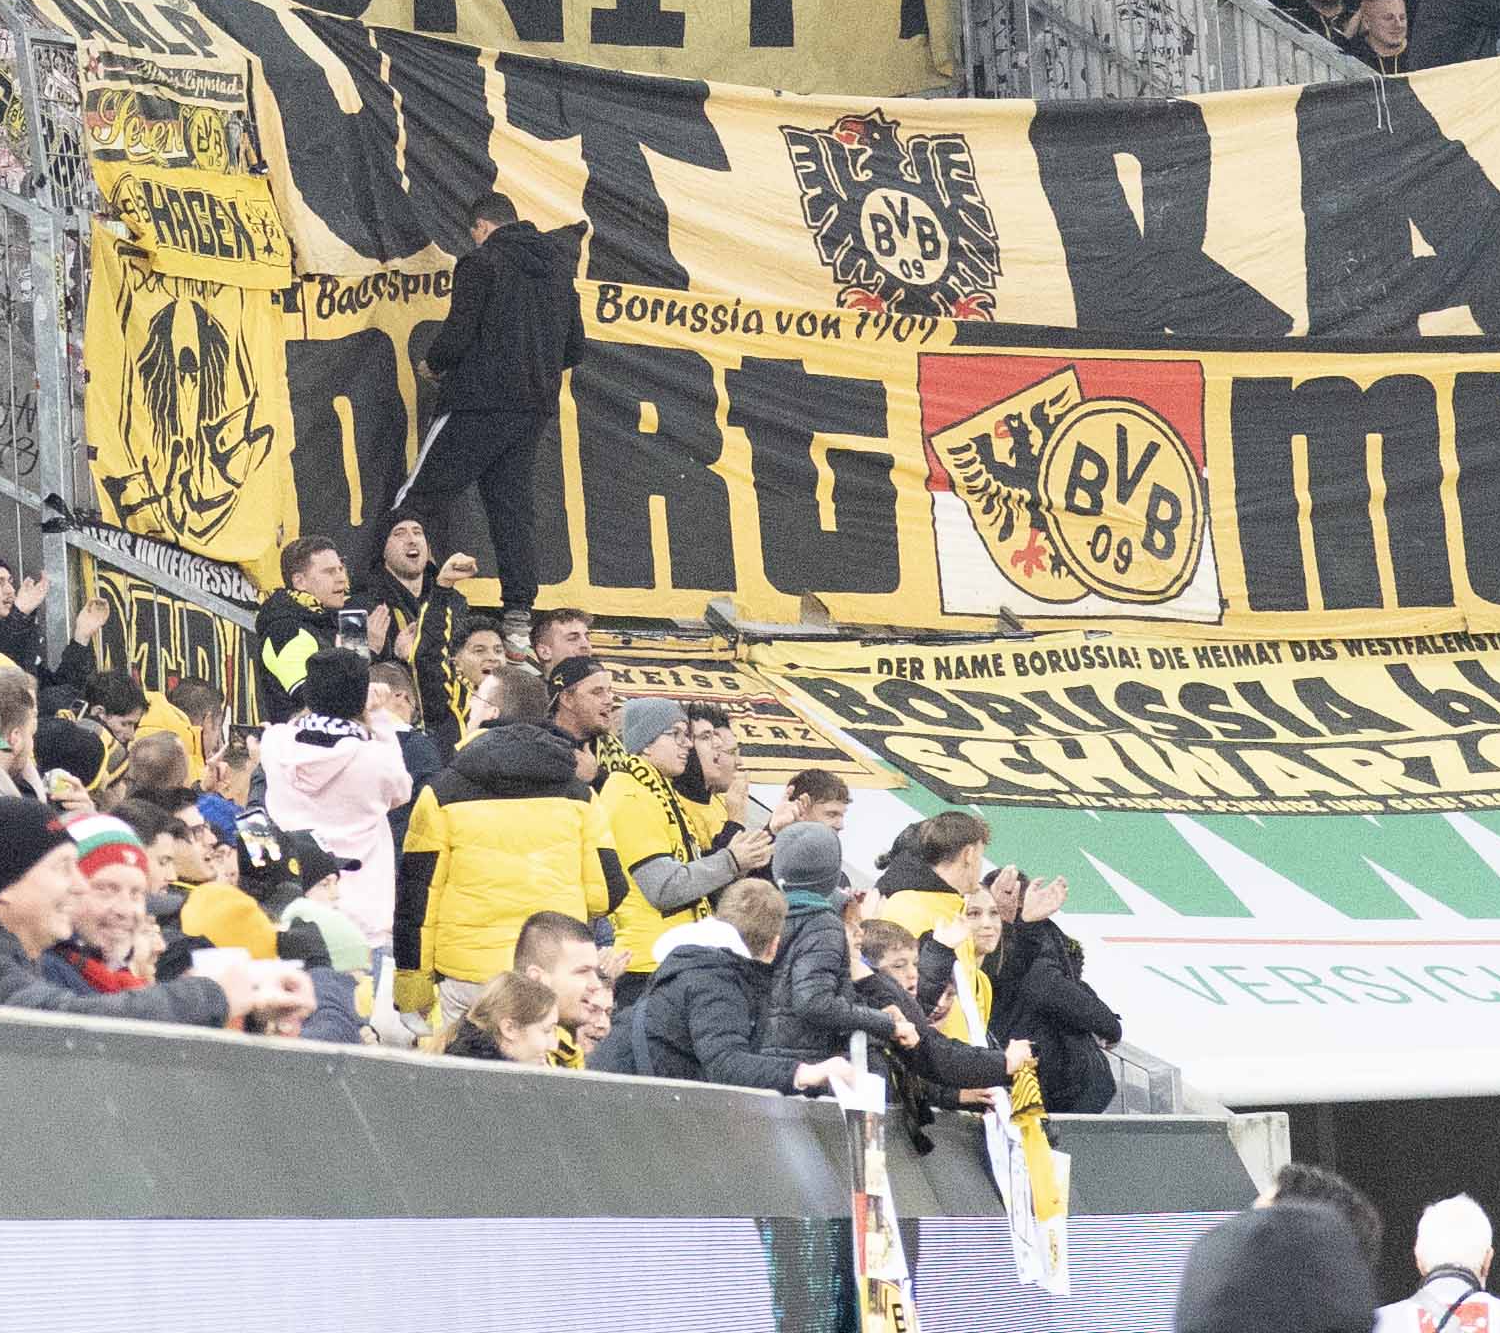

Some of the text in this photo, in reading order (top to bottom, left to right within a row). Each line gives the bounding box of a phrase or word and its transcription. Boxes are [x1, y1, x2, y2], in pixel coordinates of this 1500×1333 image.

[870, 196, 943, 260] BVB
[899, 257, 926, 279] 09
[597, 282, 764, 335] Borussia
[776, 307, 842, 339] von
[856, 309, 940, 345] 1909
[1064, 423, 1181, 560] BVB
[1088, 525, 1131, 574] 09
[878, 657, 922, 680] DER
[935, 653, 1005, 680] NAME
[1016, 645, 1140, 677] BORUSSIA!
[1150, 647, 1189, 670] DIE
[1195, 641, 1281, 669] HEIMAT
[1294, 639, 1337, 661] DAS
[787, 675, 1414, 739] BORUSSIA
